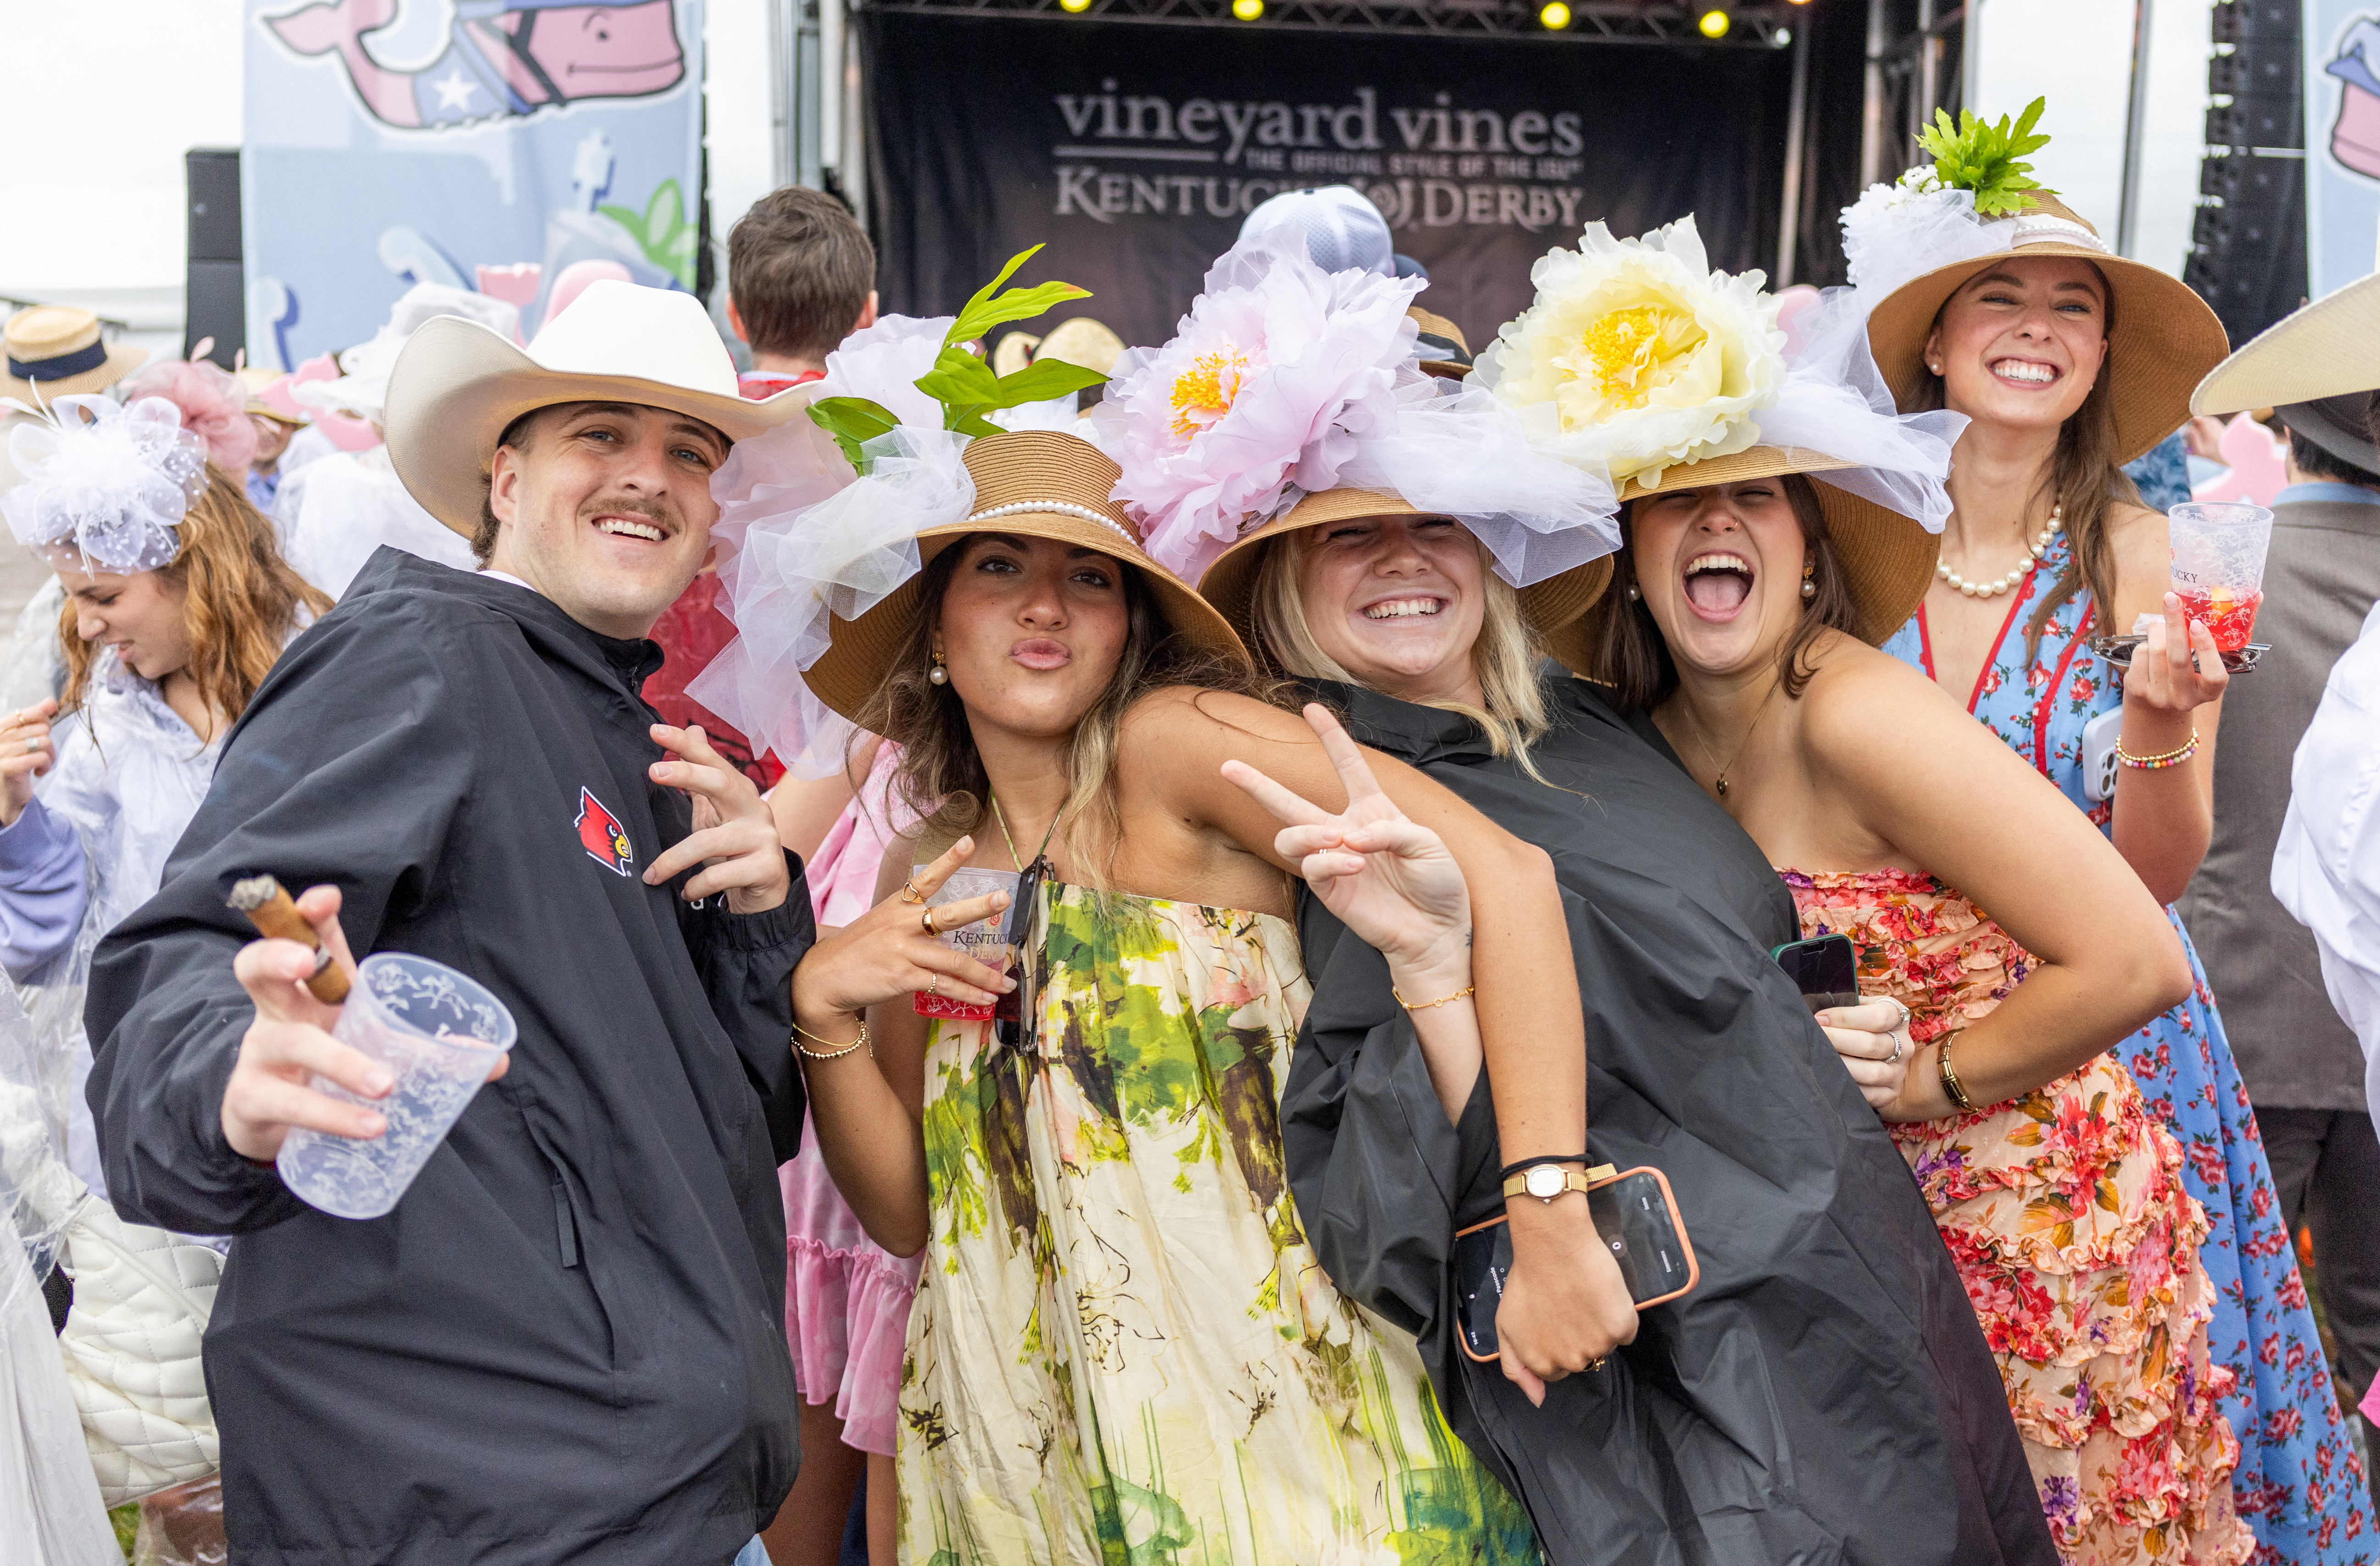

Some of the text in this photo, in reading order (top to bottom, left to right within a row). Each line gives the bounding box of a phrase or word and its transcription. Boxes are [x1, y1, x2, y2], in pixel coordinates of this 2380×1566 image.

[1056, 77, 1583, 163] vineyard vines
[1245, 148, 1284, 169] THE
[1290, 149, 1380, 175] OFFICIAL
[1389, 153, 1451, 177] STYLE
[1458, 155, 1485, 178] OF
[1493, 155, 1531, 178] THE
[1056, 165, 1583, 233] KENTUC DERBY
[953, 931, 1009, 946] KENTUCK
[1490, 1267, 1502, 1293] Passcode
